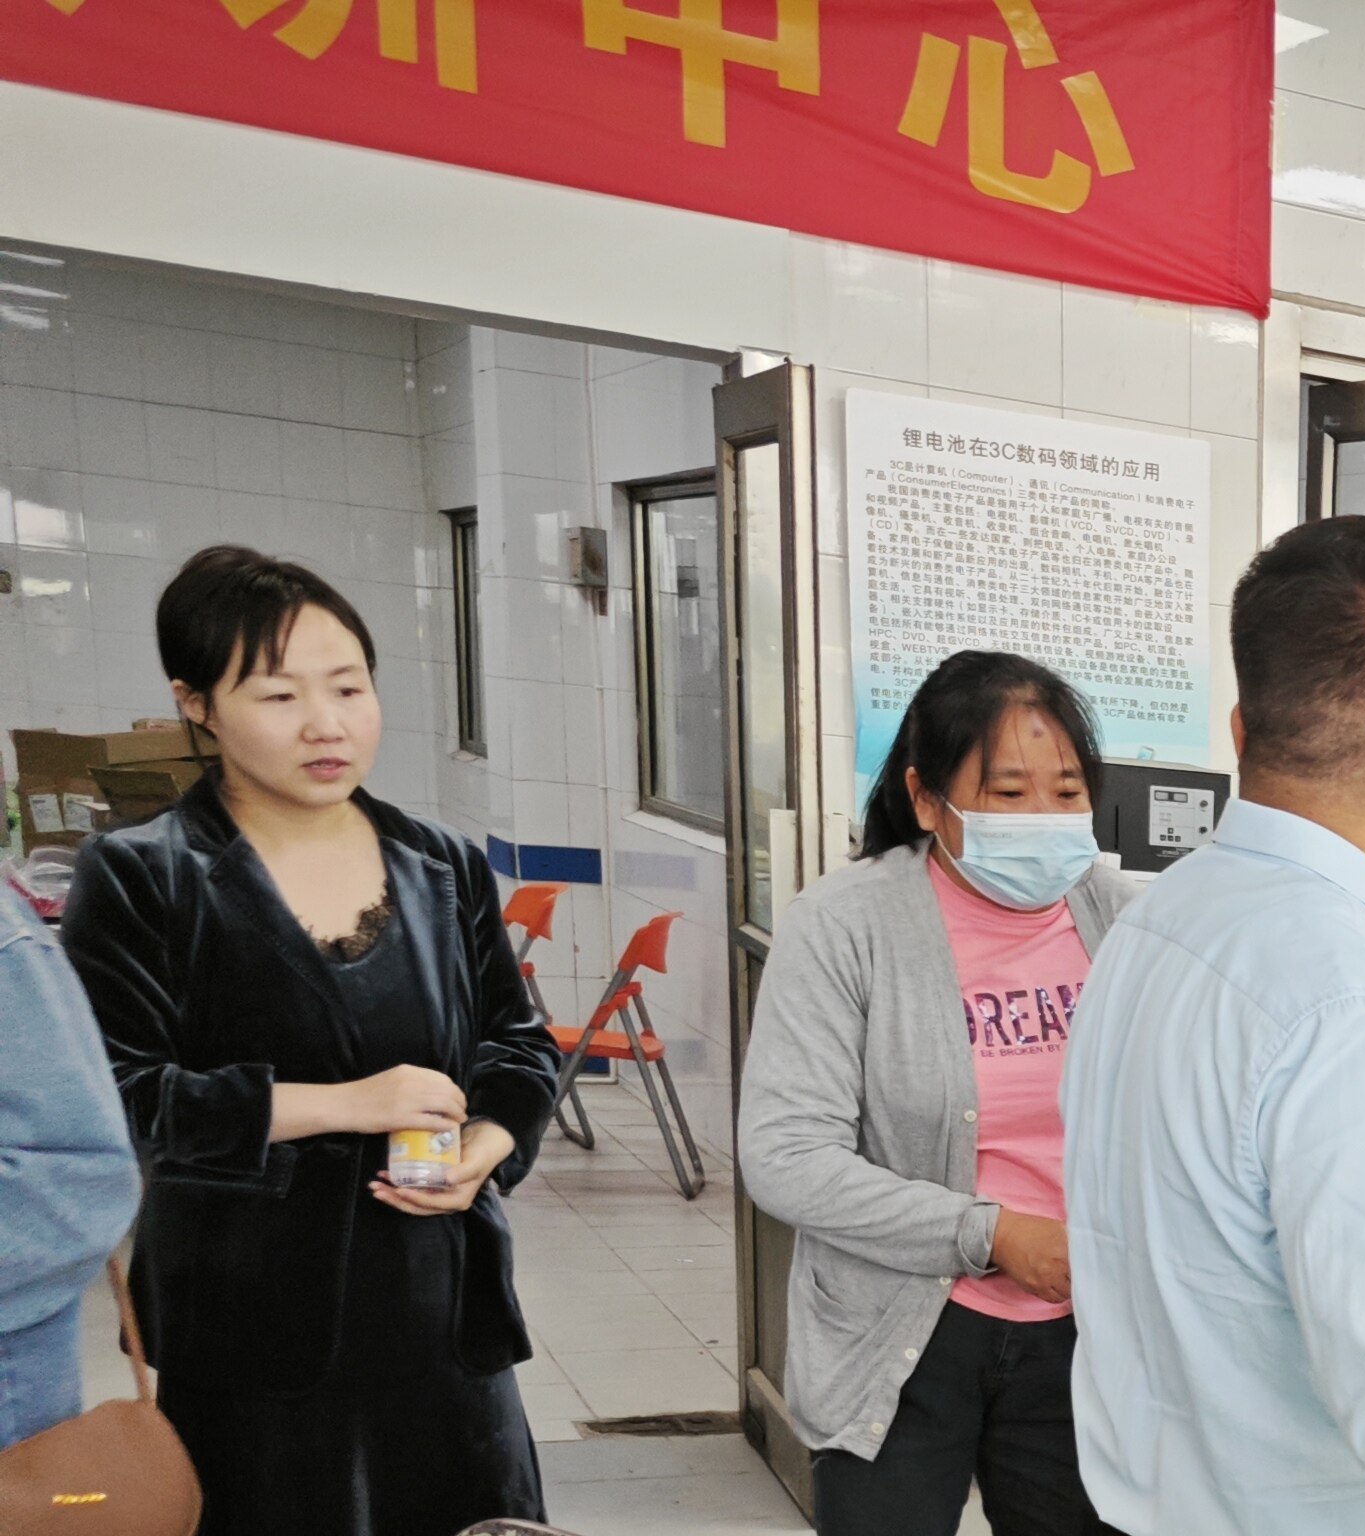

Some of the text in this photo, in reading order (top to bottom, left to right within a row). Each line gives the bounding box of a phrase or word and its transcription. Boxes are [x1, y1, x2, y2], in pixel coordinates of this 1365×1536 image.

[902, 427, 1161, 482] 锂电池在3C数码领域的应用
